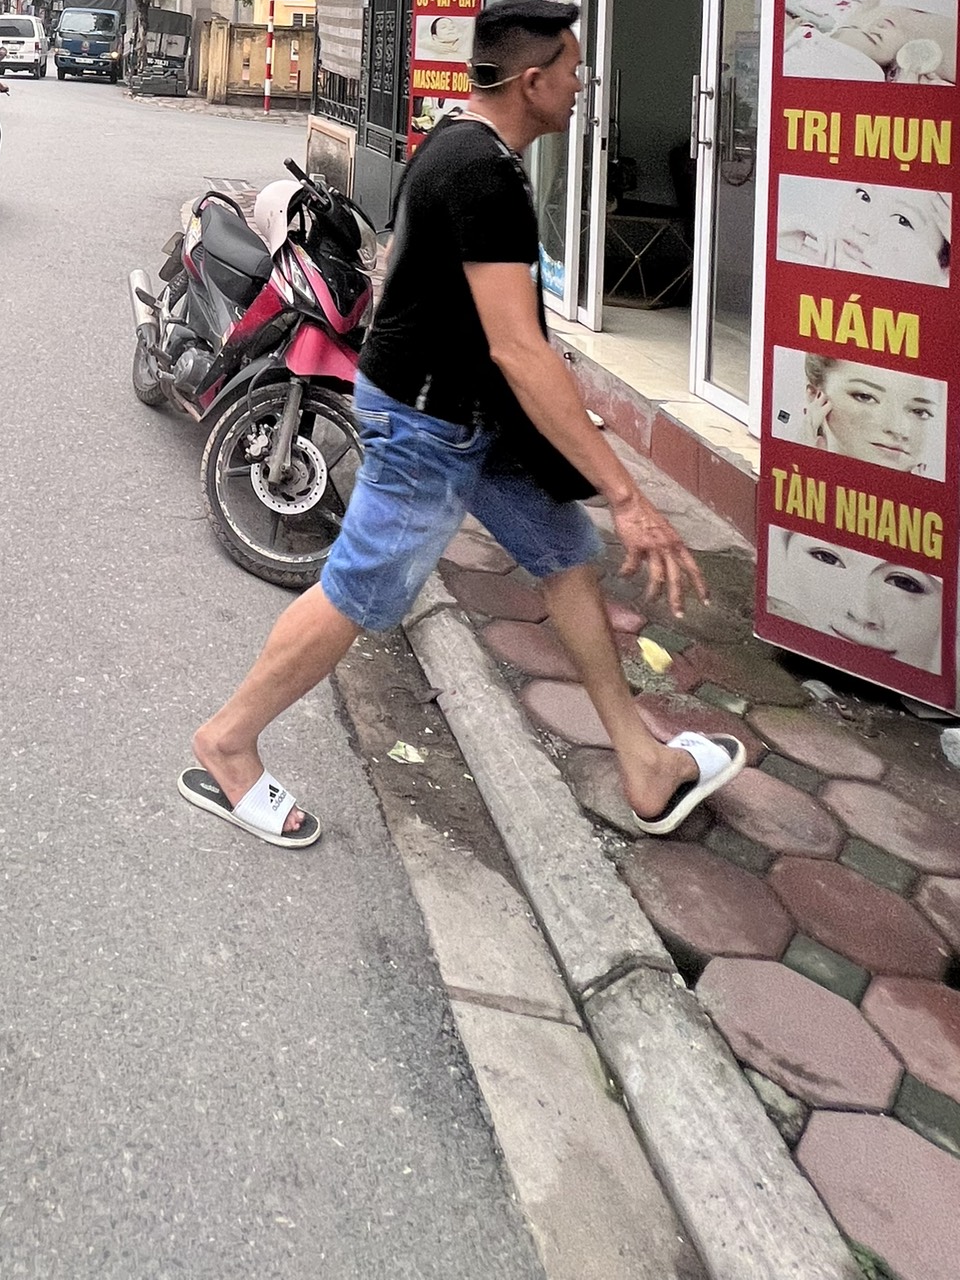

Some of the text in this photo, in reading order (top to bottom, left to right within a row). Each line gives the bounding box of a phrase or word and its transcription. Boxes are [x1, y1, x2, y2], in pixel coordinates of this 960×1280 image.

[413, 69, 451, 91] MASSAGE
[783, 108, 952, 172] TRỊ MỤN
[798, 293, 920, 359] NÁM
[771, 463, 944, 560] TÀN NHANG
